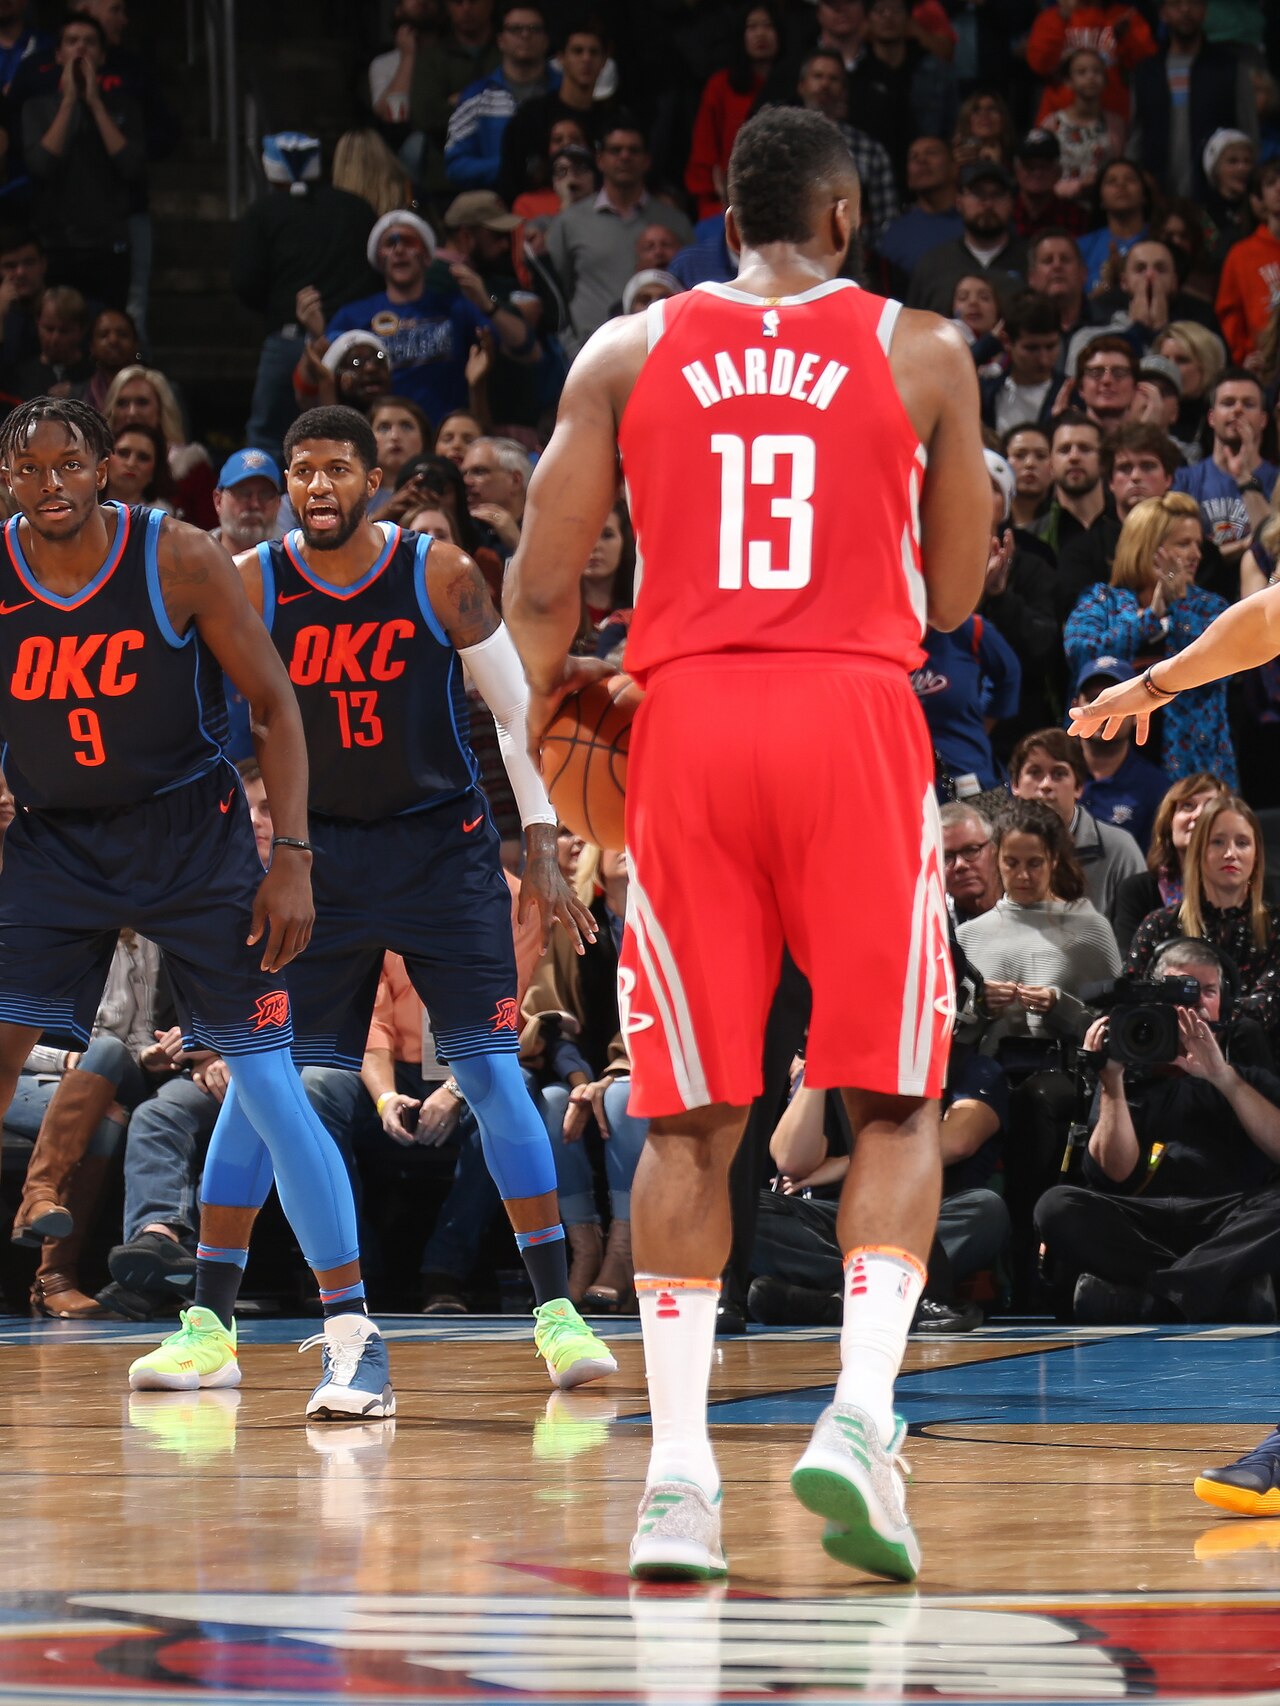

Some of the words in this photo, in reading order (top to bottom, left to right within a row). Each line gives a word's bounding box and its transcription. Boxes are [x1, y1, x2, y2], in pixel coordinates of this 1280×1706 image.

[681, 348, 850, 411] HARDEN
[710, 433, 816, 590] 13
[10, 629, 145, 701] OKC
[289, 618, 416, 686] OKC
[67, 707, 106, 767] 9
[329, 690, 384, 749] 13
